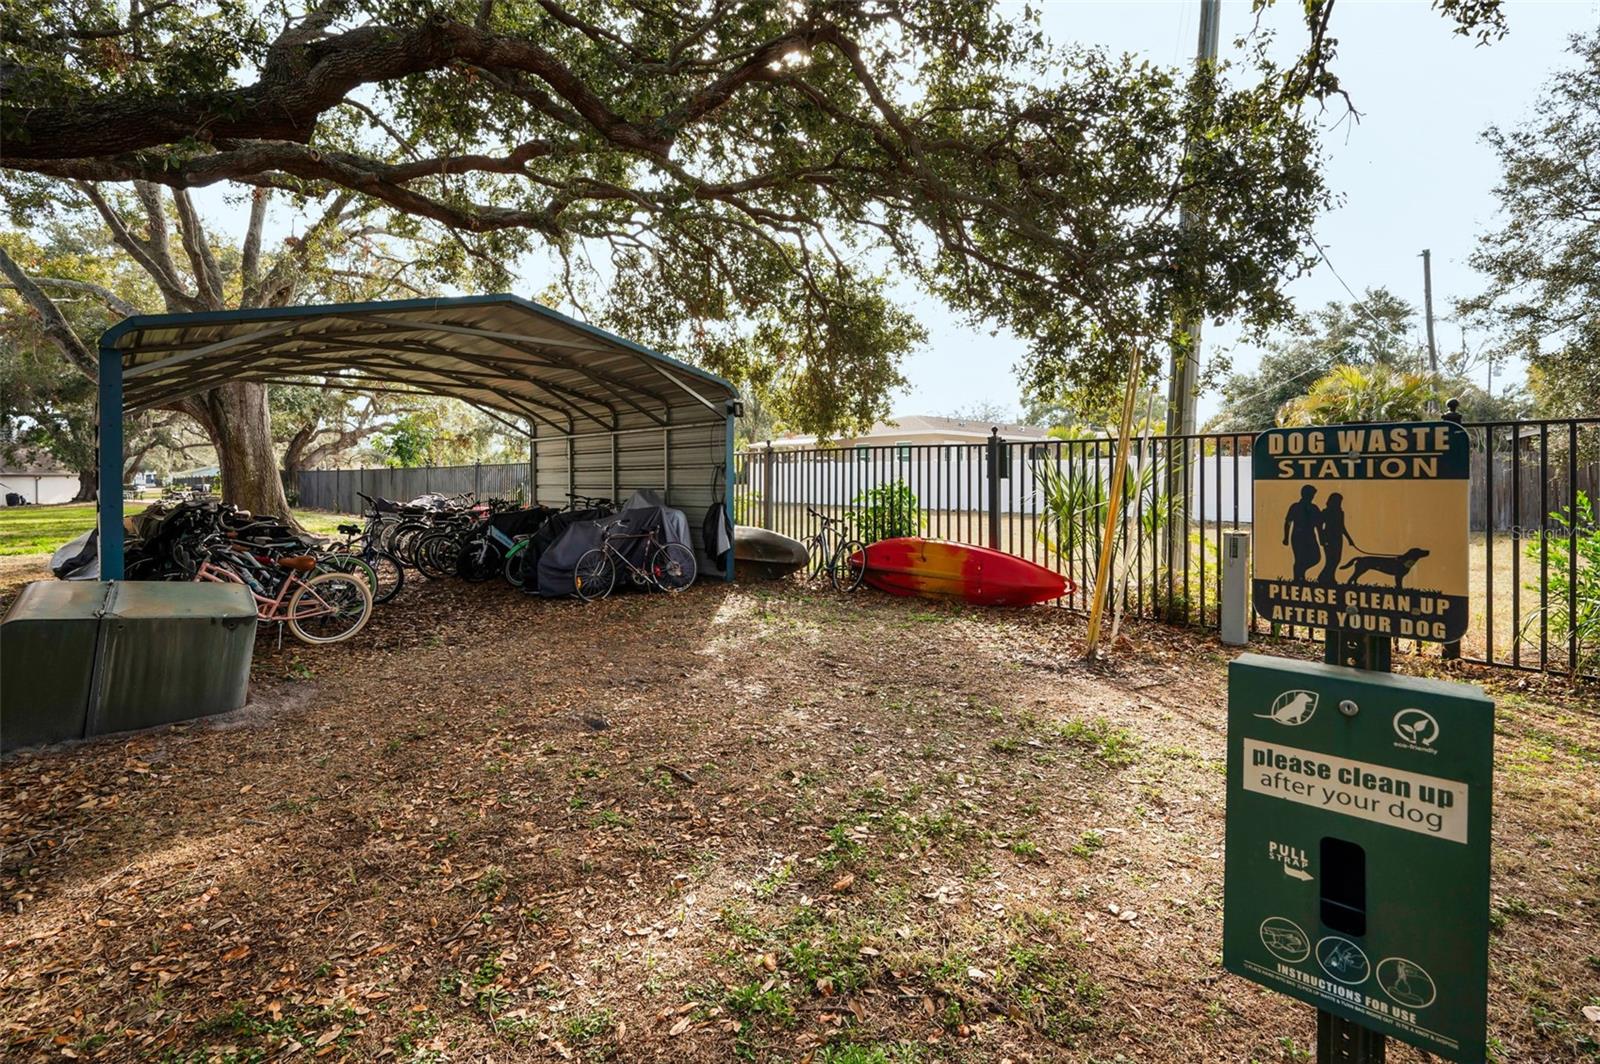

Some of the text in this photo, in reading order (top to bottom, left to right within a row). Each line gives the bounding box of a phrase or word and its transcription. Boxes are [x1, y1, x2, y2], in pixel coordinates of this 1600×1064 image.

[1268, 426, 1450, 455] DOG WASTE
[1278, 457, 1438, 479] STATION
[1269, 583, 1450, 616] PLEASE CLEAN UP
[1272, 605, 1447, 639] AFTER YOUR DOG
[1252, 748, 1454, 809] please clean up
[1260, 771, 1443, 832] after your dog
[1269, 841, 1308, 862] PULL
[1269, 852, 1308, 868] STRAP
[1277, 963, 1362, 1003] INSTRUCTIONS
[1365, 996, 1389, 1013] FOR
[1392, 1006, 1417, 1024] USE
